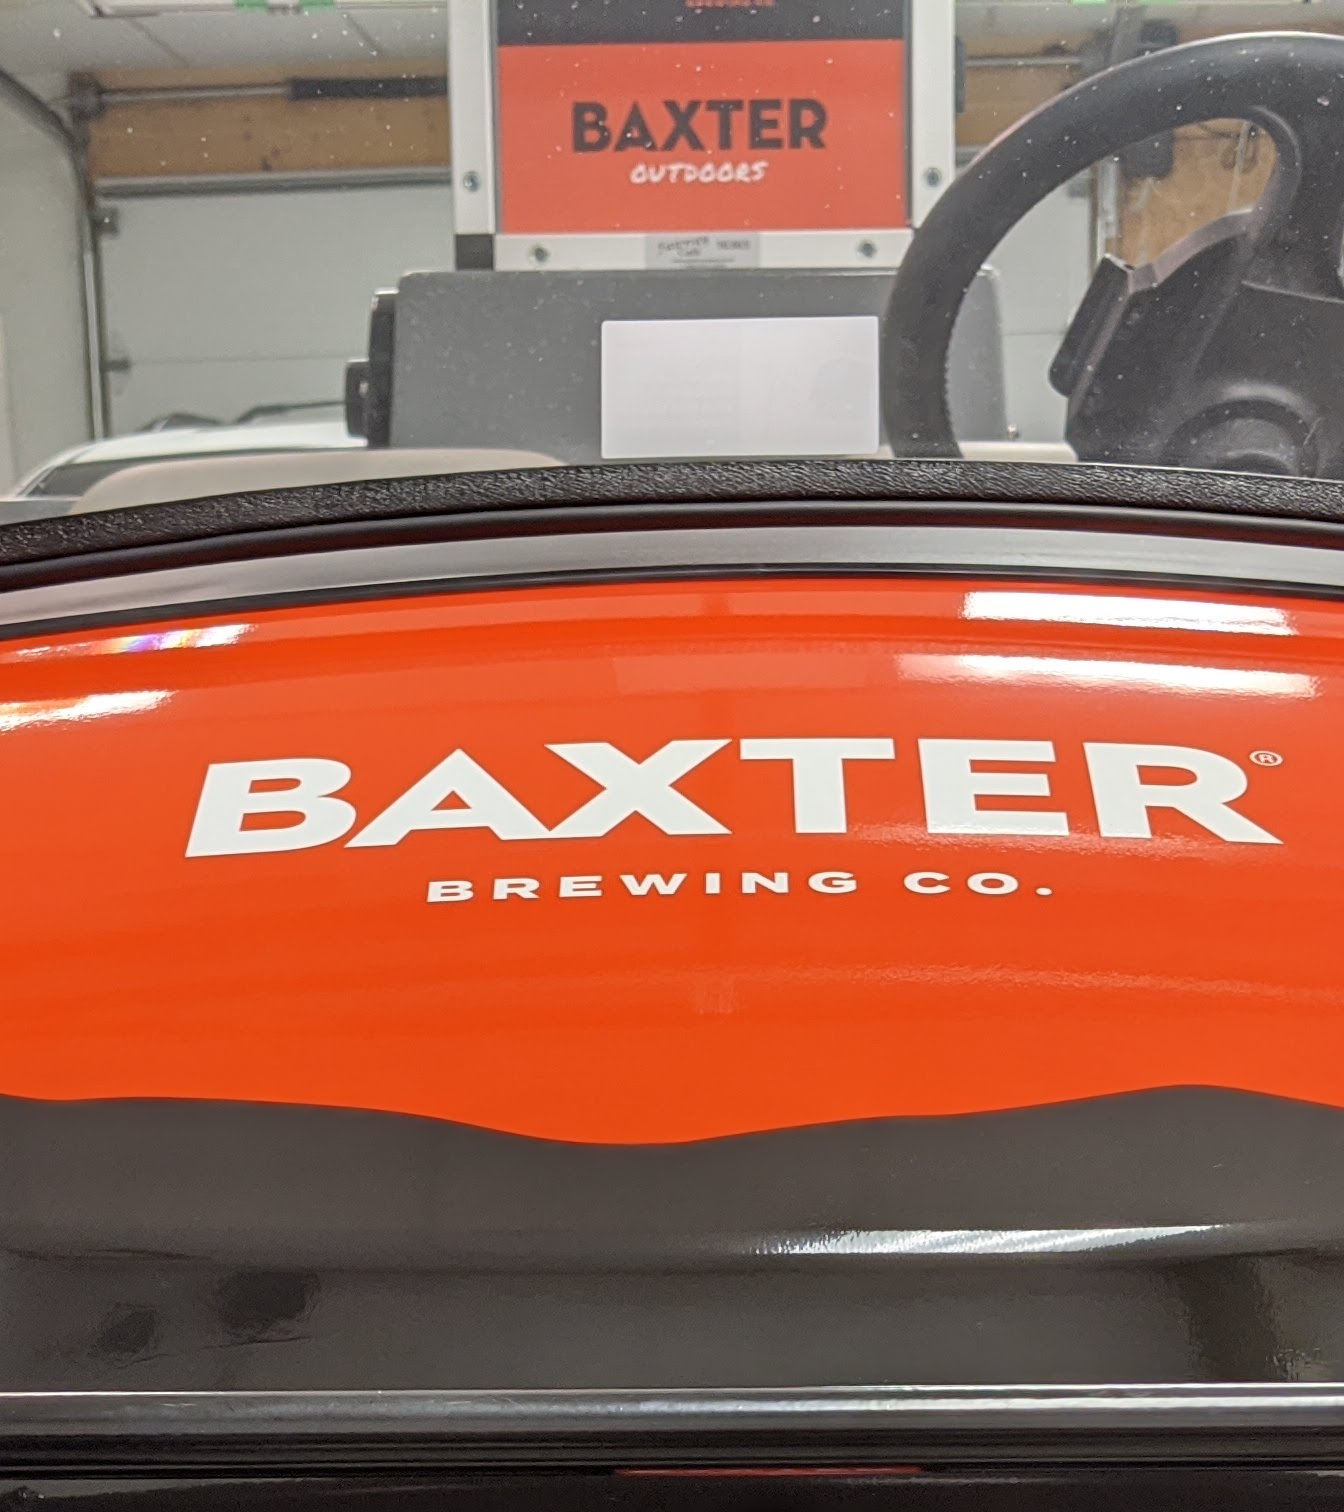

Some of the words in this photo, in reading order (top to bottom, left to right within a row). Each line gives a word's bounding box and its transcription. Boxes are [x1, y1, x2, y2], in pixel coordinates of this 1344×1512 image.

[572, 98, 827, 152] BAXTER
[630, 160, 769, 184] OUTDOORS
[427, 871, 857, 903] BREWING
[903, 871, 1053, 896] CO.
